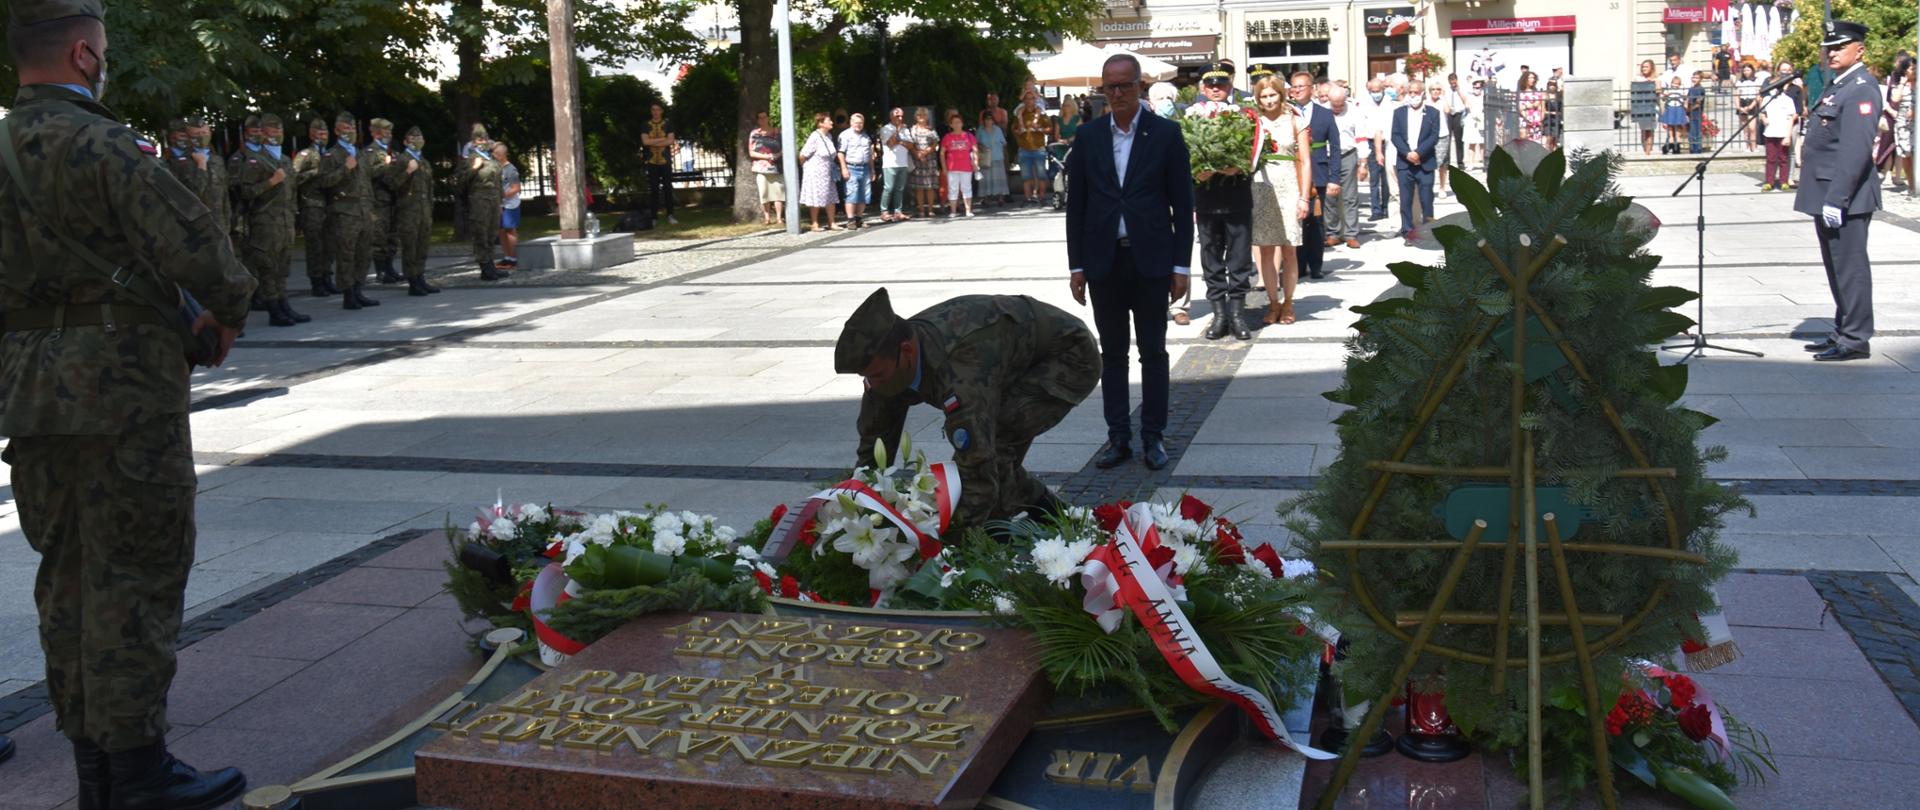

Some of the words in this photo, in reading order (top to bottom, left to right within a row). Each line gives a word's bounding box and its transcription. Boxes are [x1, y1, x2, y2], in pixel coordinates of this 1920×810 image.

[1609, 2, 1620, 10] 33
[1669, 7, 1703, 17] Millennium
[1367, 16, 1384, 25] City
[1712, 7, 1725, 22] M
[1100, 20, 1153, 32] lodziarnia
[1487, 18, 1541, 28] Millennium
[663, 616, 986, 651] OJCZYZNY
[1139, 597, 1200, 662] ANNA
[673, 635, 944, 670] OBRONIE
[741, 662, 809, 685] W
[451, 713, 948, 778] NIEZNANEMU
